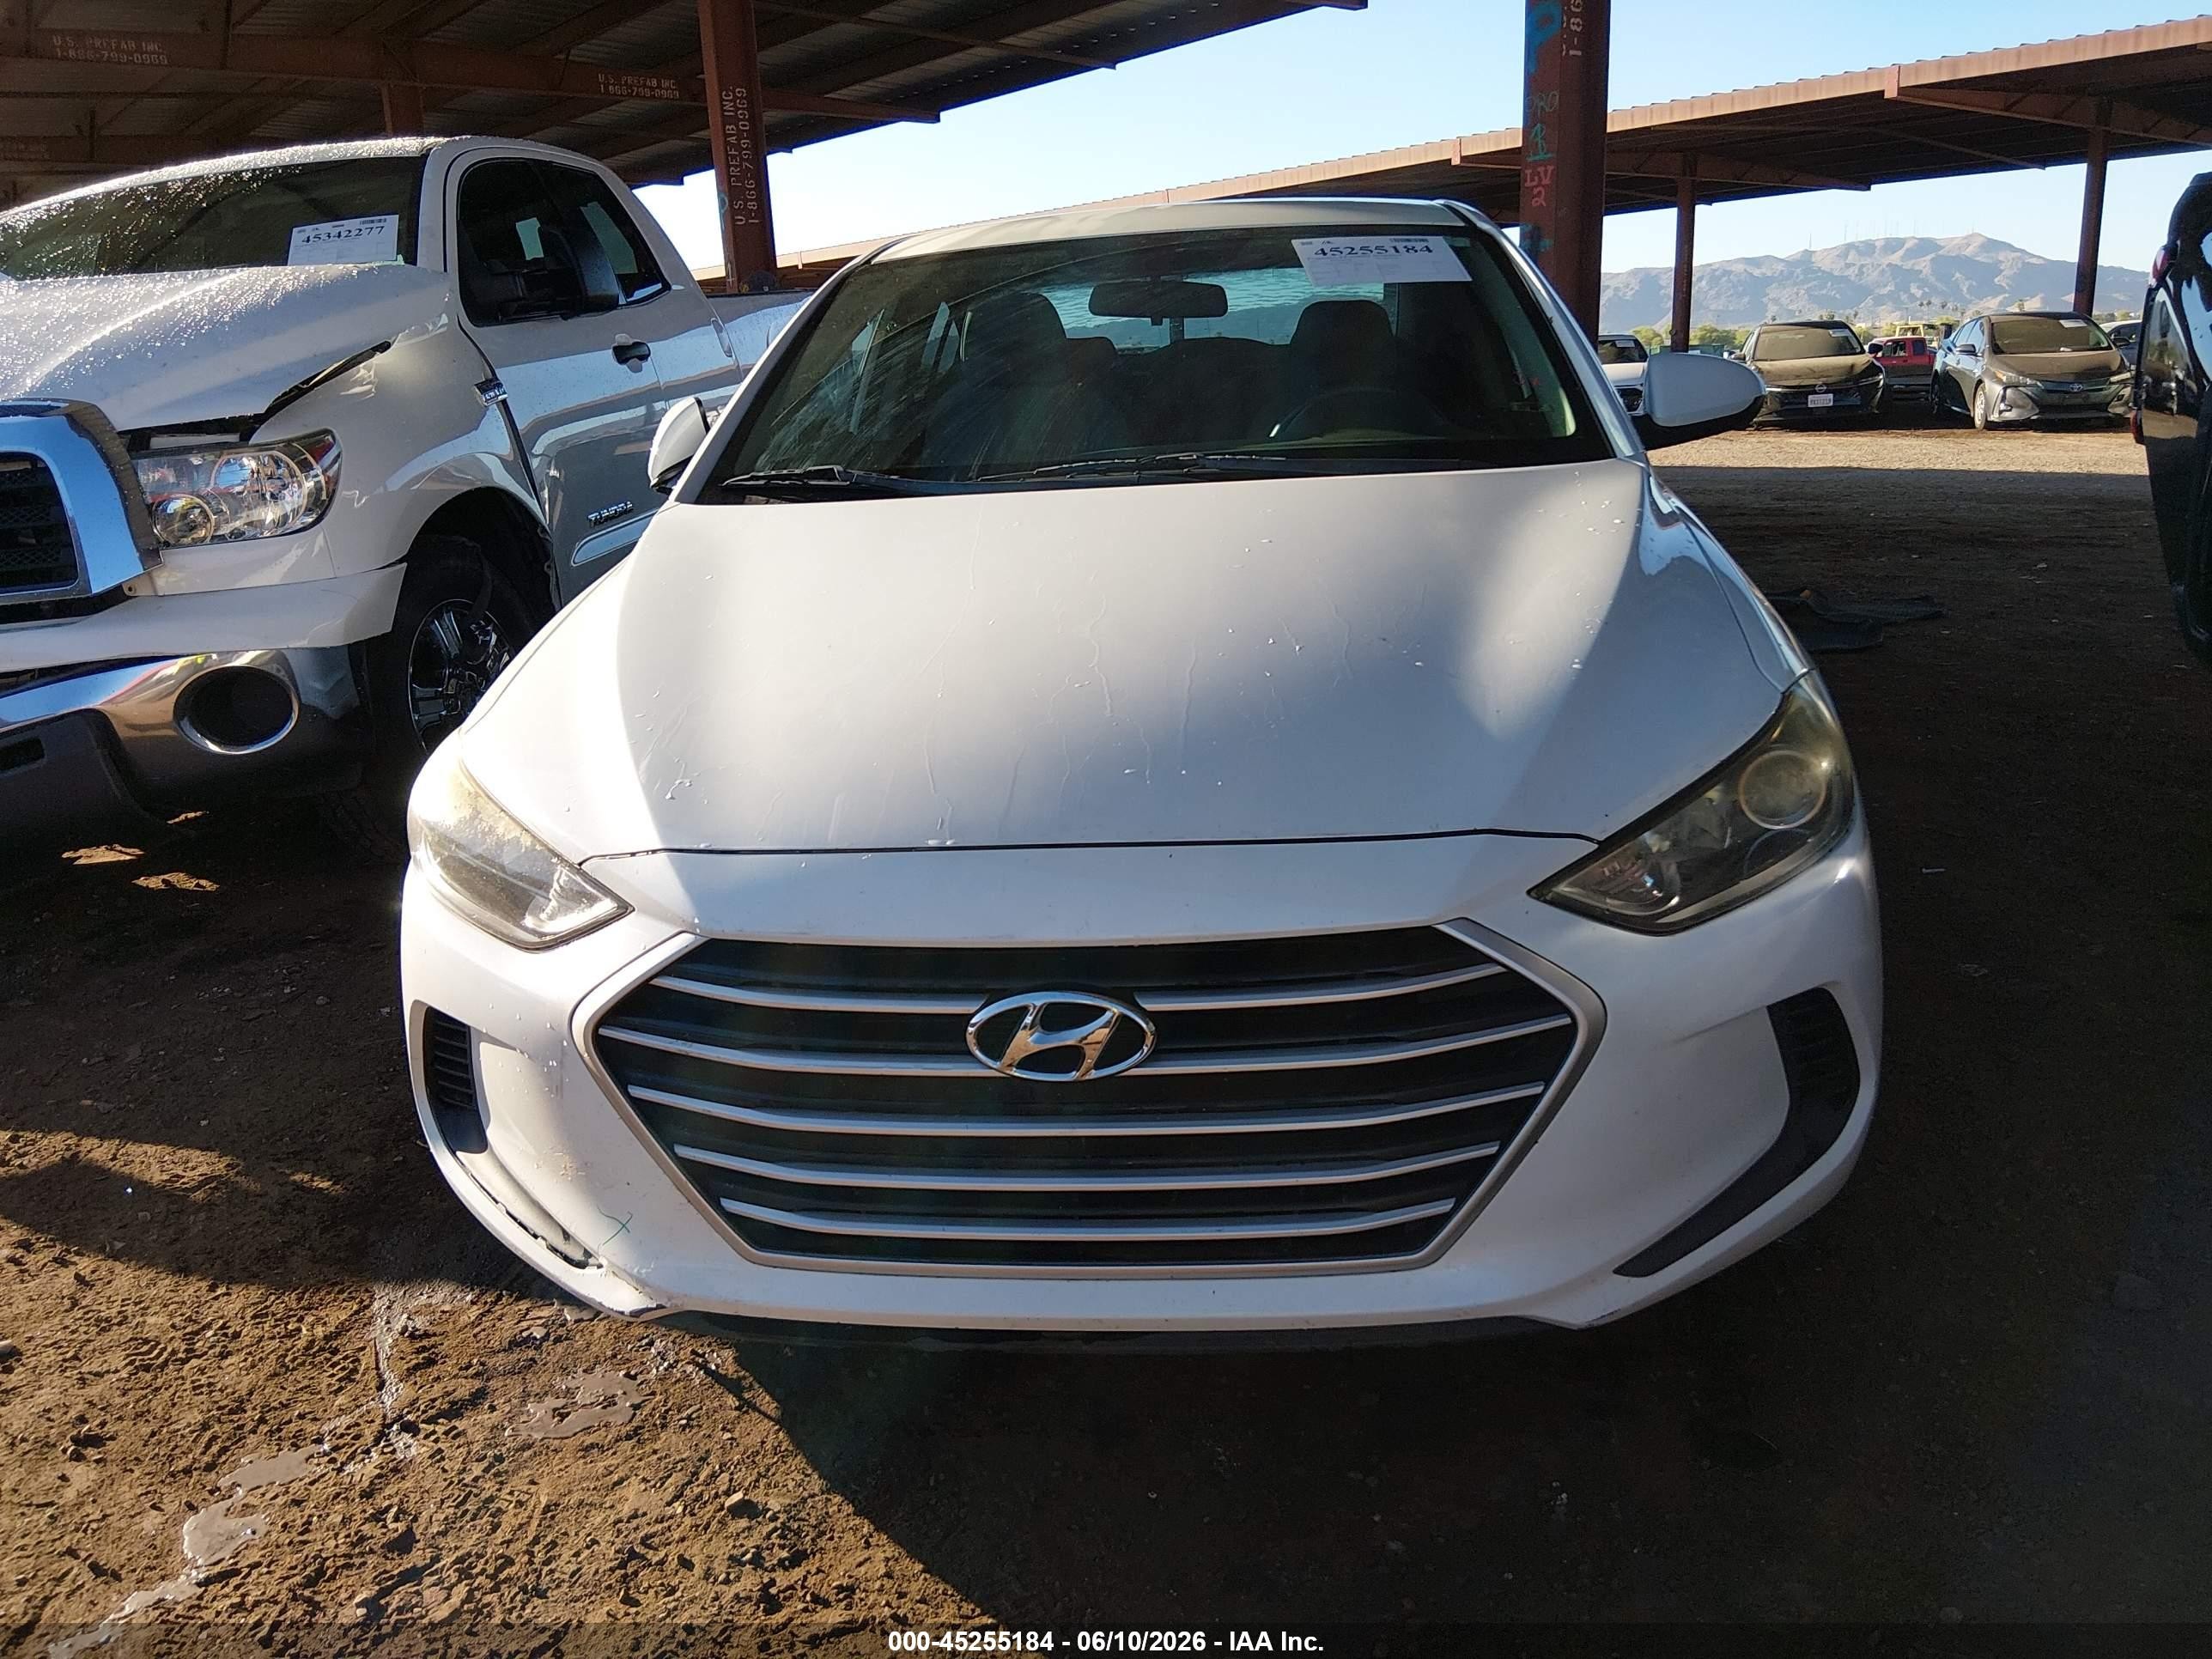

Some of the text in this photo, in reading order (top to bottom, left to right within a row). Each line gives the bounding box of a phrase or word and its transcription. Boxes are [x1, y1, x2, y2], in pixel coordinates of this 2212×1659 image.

[85, 36, 136, 51] PREFAB
[598, 73, 617, 84] U.S.
[621, 76, 658, 88] PREFAB
[721, 85, 746, 226] U.S. PREFAB INC.
[736, 88, 759, 223] 1-866-799-0969
[301, 225, 386, 244] 45342277
[1314, 244, 1434, 257] 45255184
